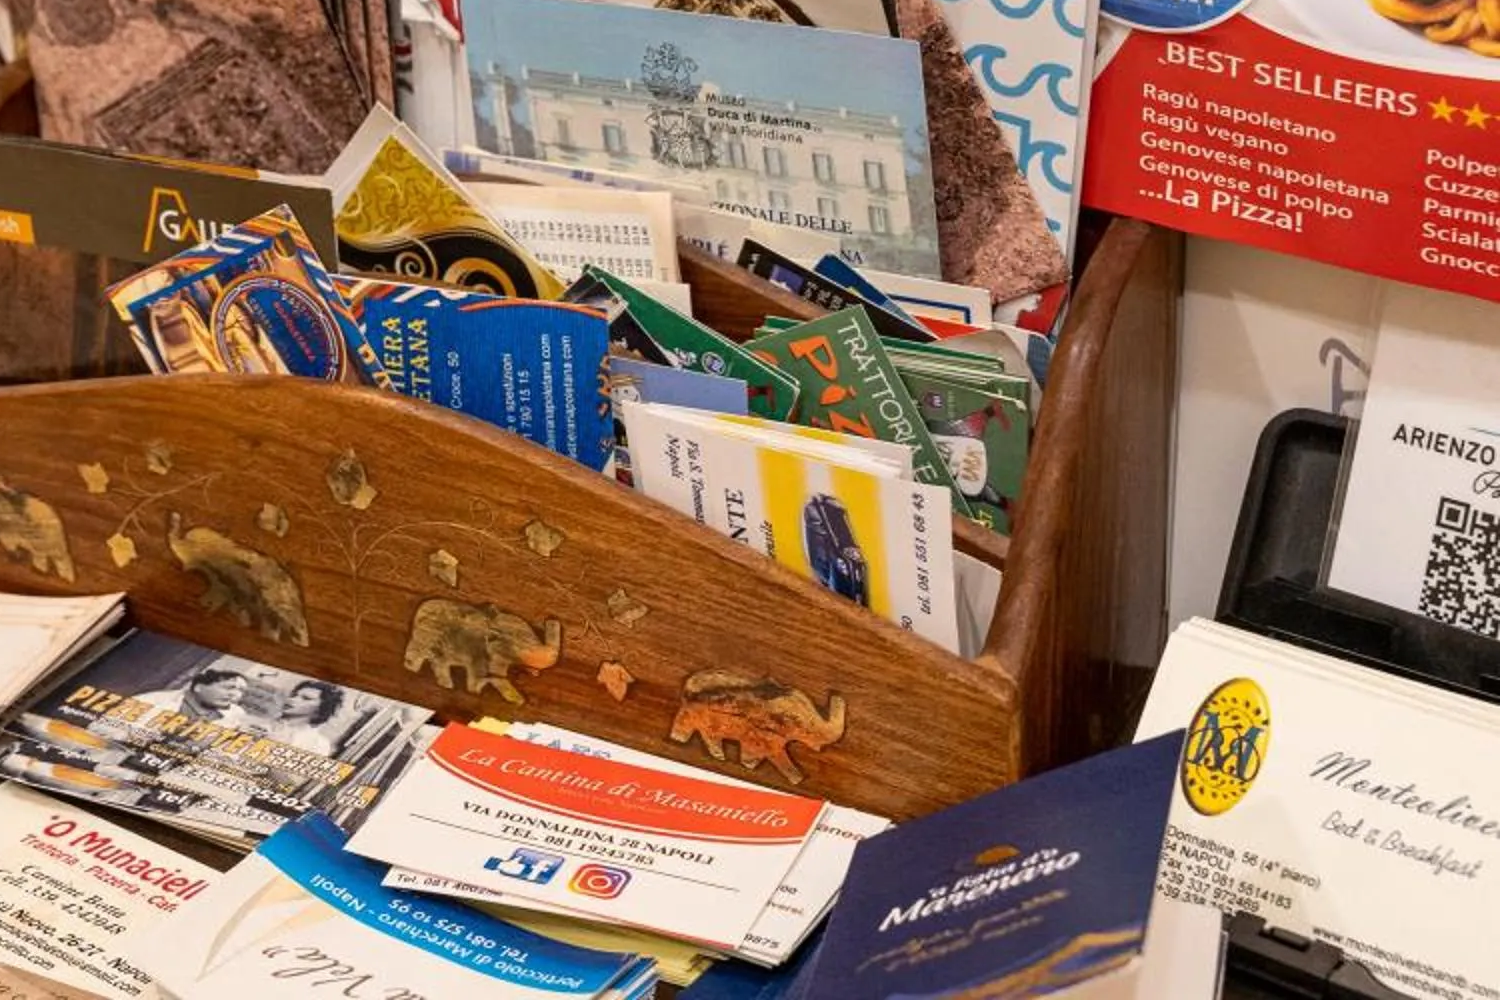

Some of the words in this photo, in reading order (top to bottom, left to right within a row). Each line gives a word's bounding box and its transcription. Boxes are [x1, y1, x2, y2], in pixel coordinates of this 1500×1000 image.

[705, 92, 746, 106] Museo
[1166, 40, 1245, 79] BEST
[1252, 63, 1420, 119] SELLEERS
[707, 106, 740, 121] Duca
[744, 110, 757, 123] di
[760, 114, 811, 130] Martina
[1142, 82, 1199, 113] Ragù
[1205, 99, 1337, 145] napoletano
[1142, 106, 1199, 135] Ragù
[1205, 124, 1289, 157] vegano
[1138, 155, 1251, 194] Genovese
[1256, 182, 1280, 202] di
[1284, 191, 1354, 224] polpo
[1140, 131, 1252, 171] Genovese
[1257, 161, 1391, 206] napoletana
[795, 212, 853, 235] DELLE
[1210, 189, 1305, 235] Pizza!
[837, 316, 923, 460] TRATTORIA
[1392, 423, 1496, 467] ARIENZO
[65, 684, 144, 722] PIZZE
[457, 744, 494, 768] La
[499, 753, 604, 794] Cantina
[607, 776, 637, 800] di
[638, 785, 790, 831] Masaniello
[461, 799, 494, 818] VIA
[494, 807, 617, 846] DONNALBINA
[642, 841, 716, 867] NAPOLI
[542, 832, 574, 850] 081
[1321, 810, 1359, 838] Bed
[1379, 829, 1484, 881] Breakfast
[396, 872, 420, 887] Tel.
[1178, 842, 1232, 873] NAPOLI
[309, 873, 368, 911] Napoli
[877, 849, 1082, 933] Marenaro
[378, 910, 474, 962] Marechiaro
[464, 927, 495, 948] 081
[499, 944, 531, 964] Tel.
[480, 950, 499, 968] di
